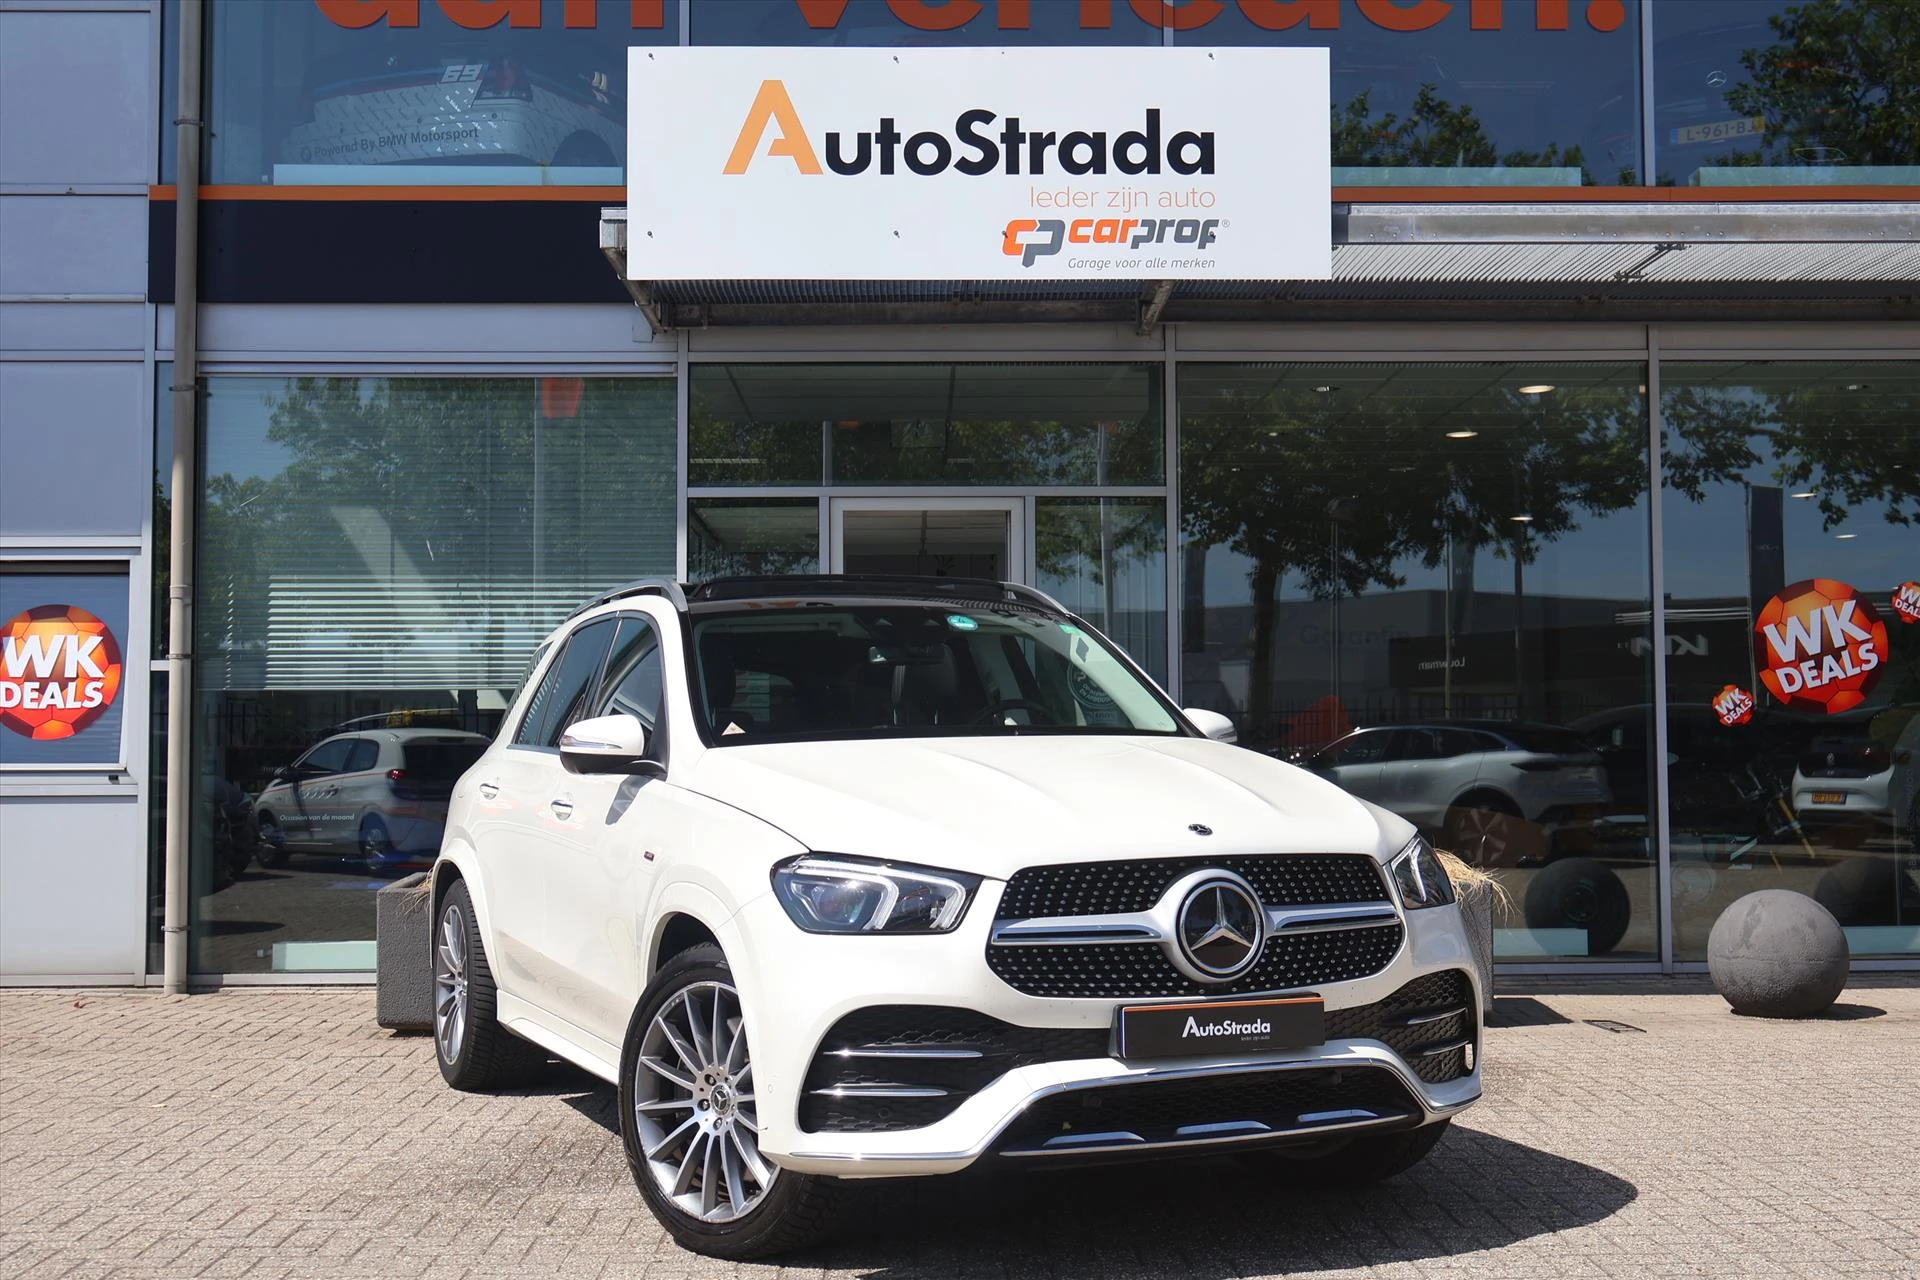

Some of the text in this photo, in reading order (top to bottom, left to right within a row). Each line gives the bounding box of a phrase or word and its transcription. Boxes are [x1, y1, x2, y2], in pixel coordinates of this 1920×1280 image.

[440, 64, 483, 83] 69
[722, 79, 1216, 176] AutoStrada
[314, 127, 480, 158] Powered By BMW Motorsport
[1030, 185, 1216, 213] Ieder zijn auto
[1068, 257, 1216, 271] Garage voor alle merken
[1763, 599, 1873, 664] WK
[2, 634, 105, 679] WK
[1775, 642, 1879, 694] DEALS
[0, 681, 104, 709] DEALS
[1715, 687, 1748, 715] WK
[1723, 698, 1753, 725] DEALS
[321, 812, 330, 821] de
[1181, 1015, 1271, 1038] AutoStrada
